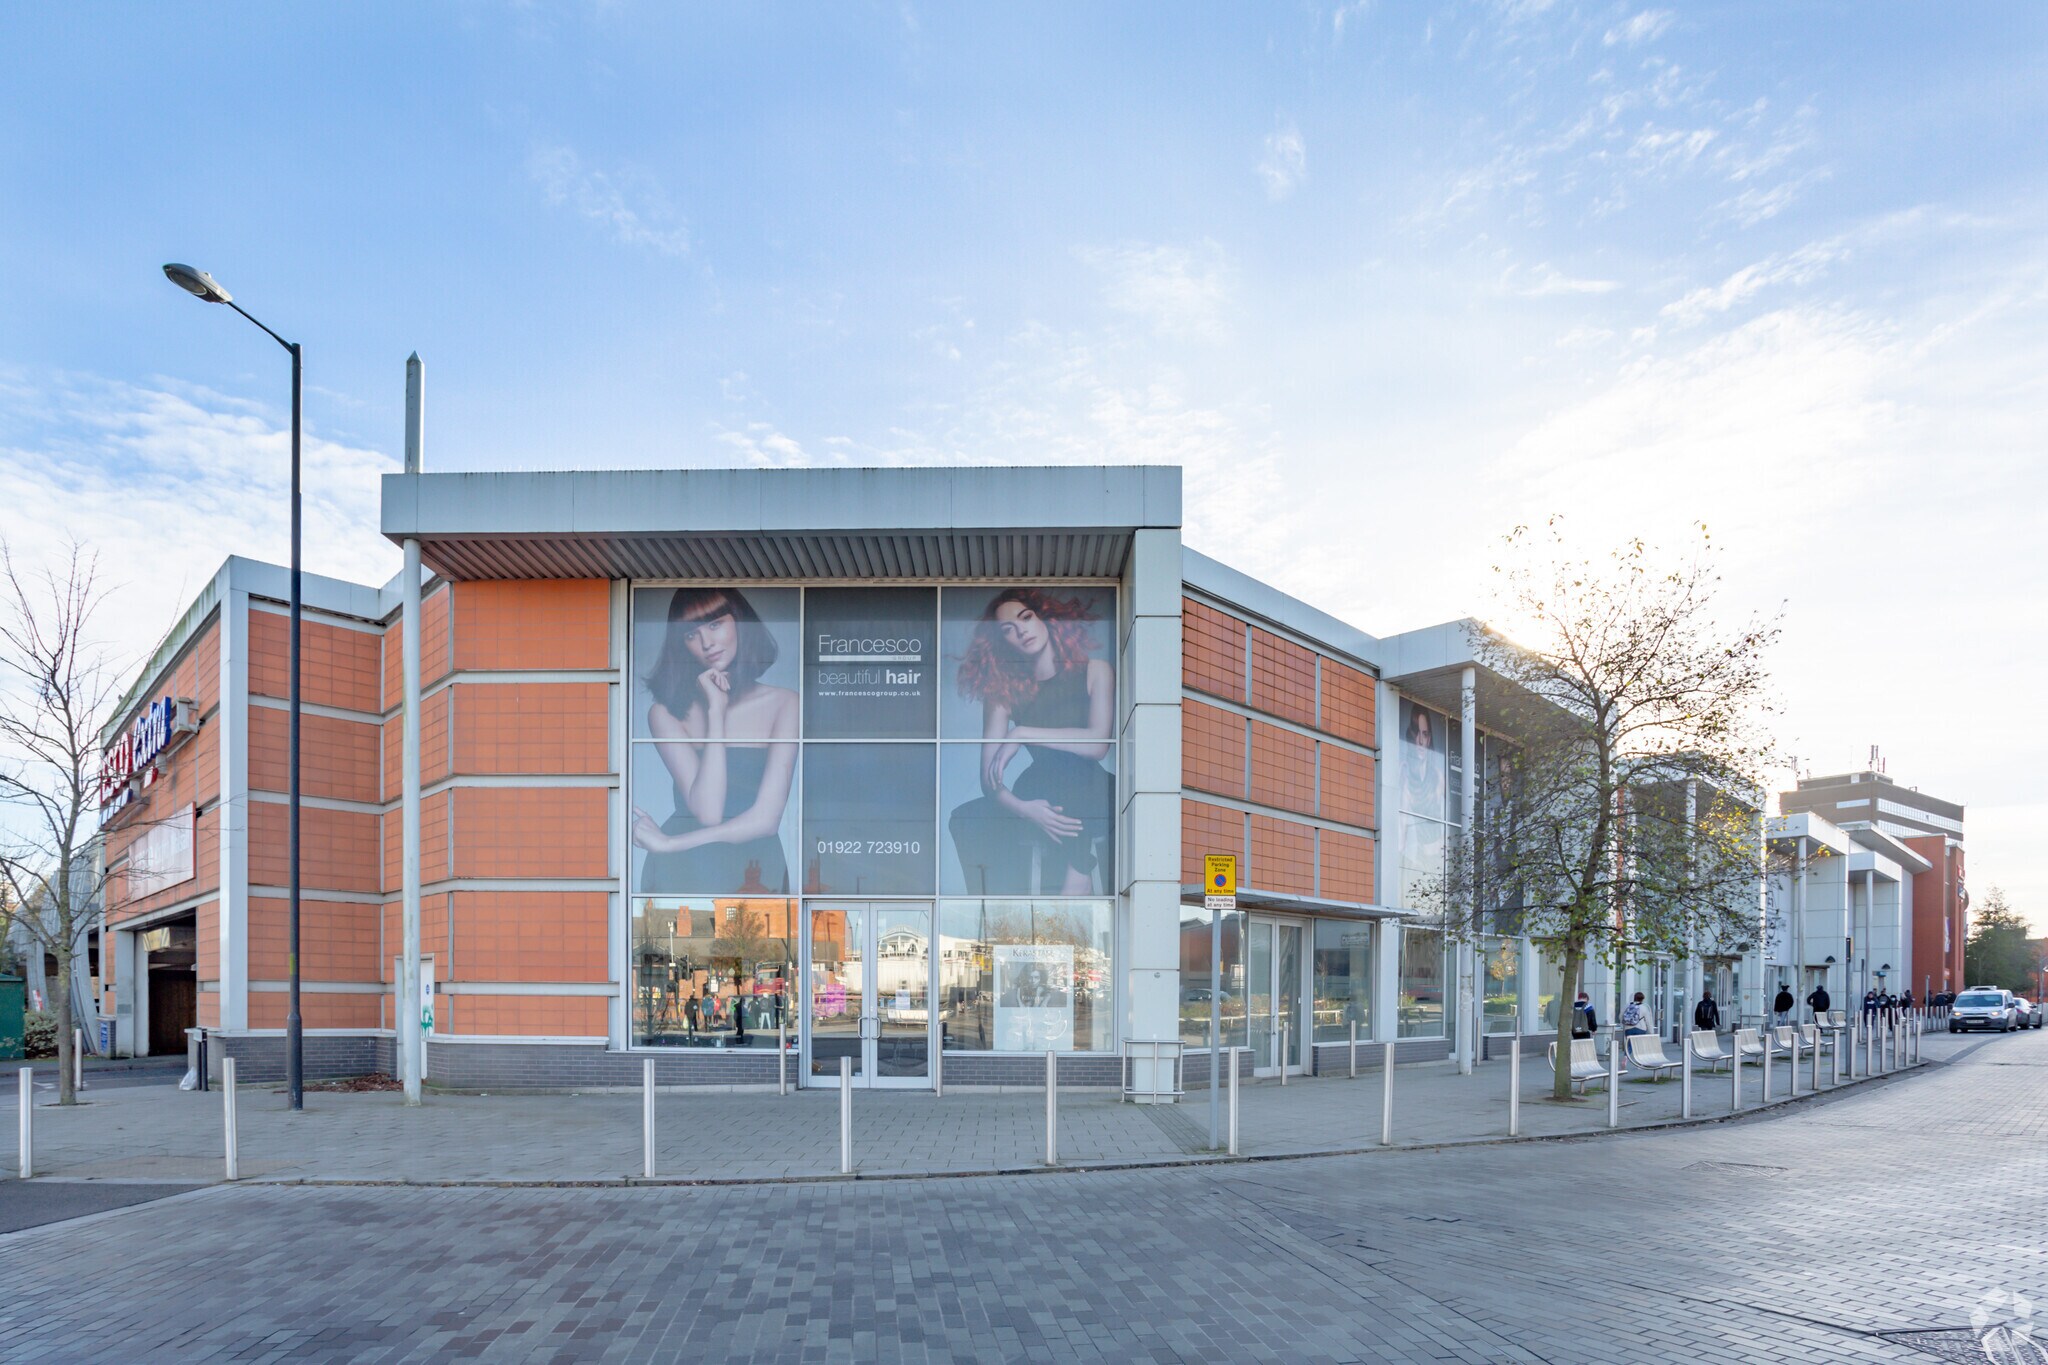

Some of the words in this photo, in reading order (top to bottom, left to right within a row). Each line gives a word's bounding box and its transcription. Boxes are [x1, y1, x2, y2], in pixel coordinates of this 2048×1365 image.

[818, 634, 922, 653] Francesco
[818, 669, 881, 685] beautiful
[885, 669, 921, 685] hair
[817, 841, 862, 854] 01922
[866, 841, 921, 854] 723910
